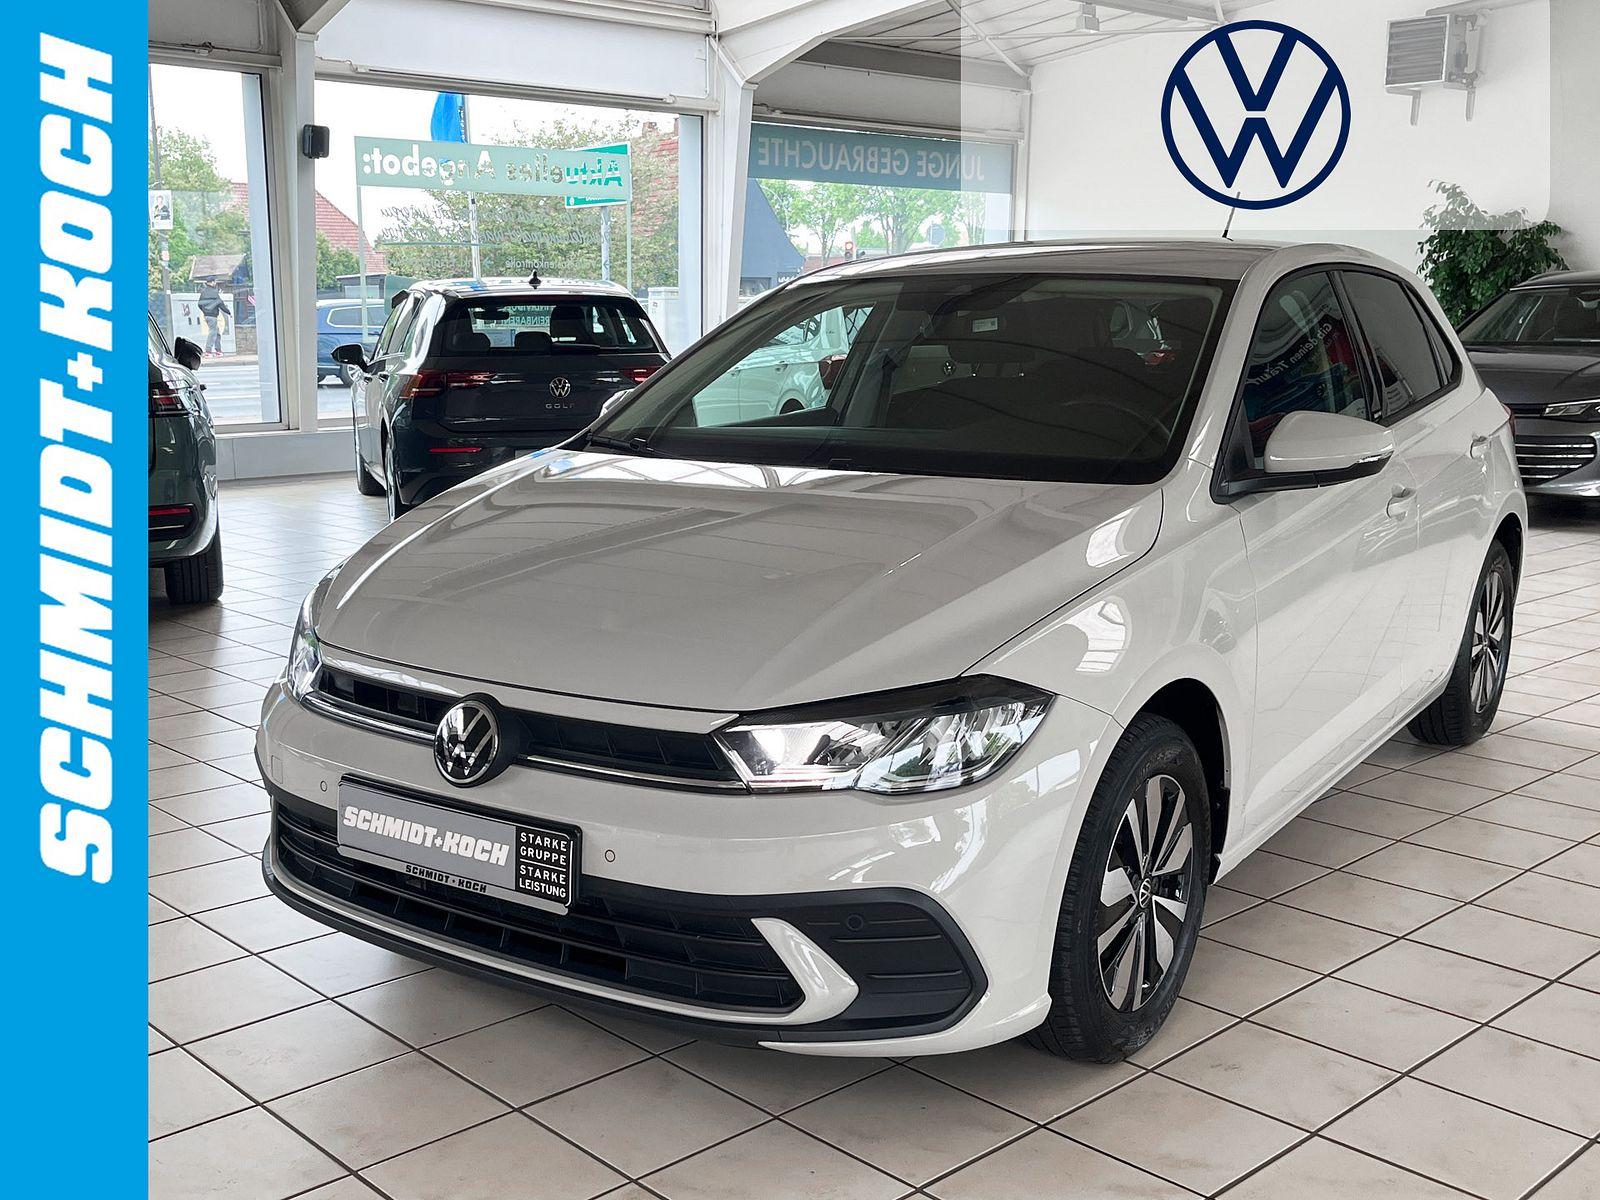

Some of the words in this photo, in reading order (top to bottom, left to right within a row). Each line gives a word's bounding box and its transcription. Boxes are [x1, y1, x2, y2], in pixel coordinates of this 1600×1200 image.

[545, 402, 576, 410] GOLF
[343, 806, 510, 866] SCHMIDT+KOCH
[520, 832, 567, 852] STARKE
[520, 845, 567, 866] GRUPPE
[405, 864, 450, 884] SCHMIDT
[457, 878, 487, 893] KOCH
[519, 864, 566, 885] STARKE
[519, 878, 567, 898] LEISTUNG
